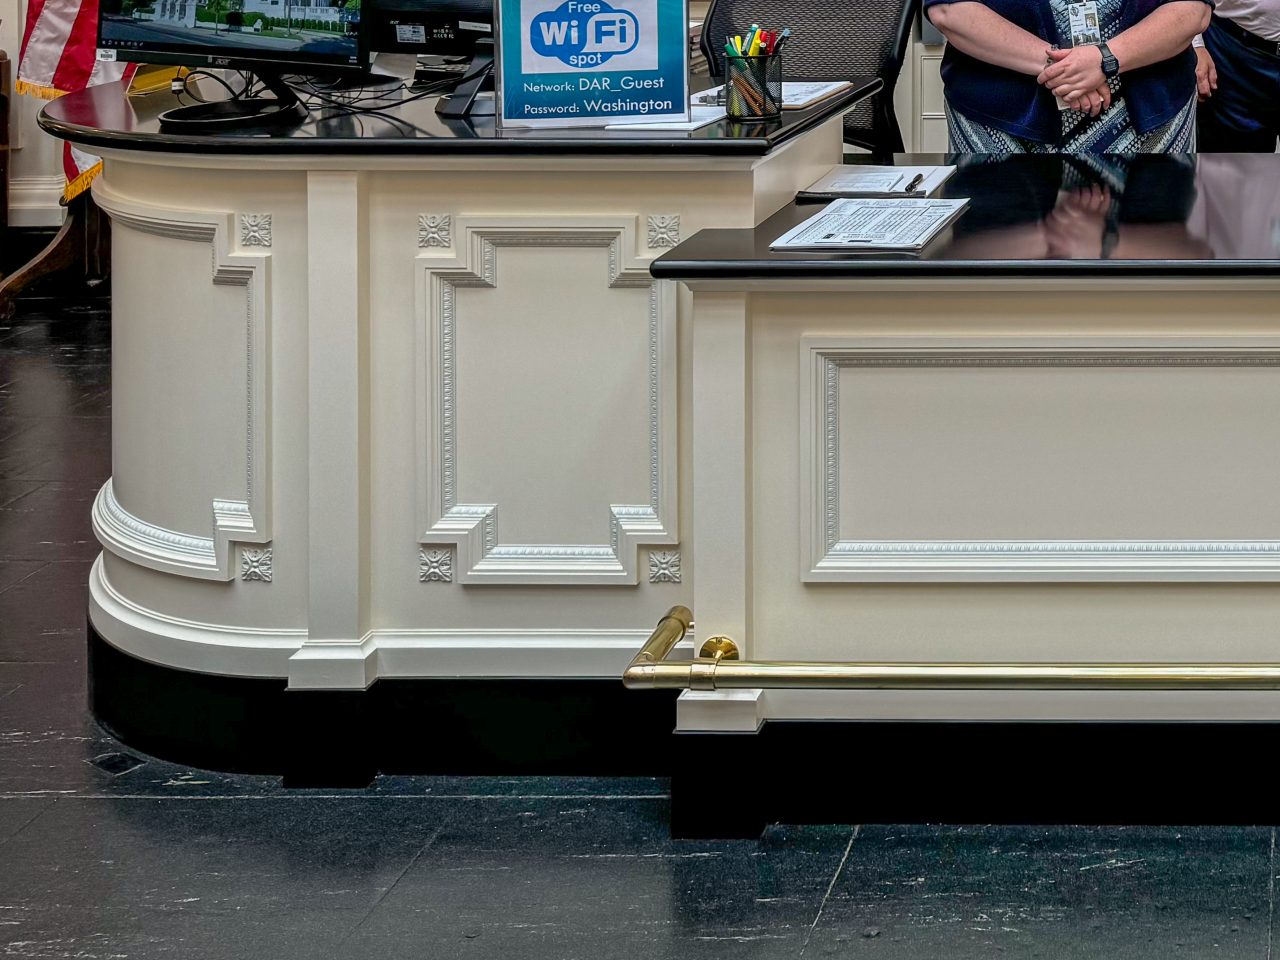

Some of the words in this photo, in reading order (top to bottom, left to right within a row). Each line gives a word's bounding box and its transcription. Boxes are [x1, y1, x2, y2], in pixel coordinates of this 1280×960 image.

[568, 1, 600, 13] Free
[570, 53, 602, 67] spot
[524, 82, 574, 93] Network:
[579, 76, 665, 92] DAR_Guest
[524, 103, 580, 115] Password:
[584, 99, 672, 114] Washington
